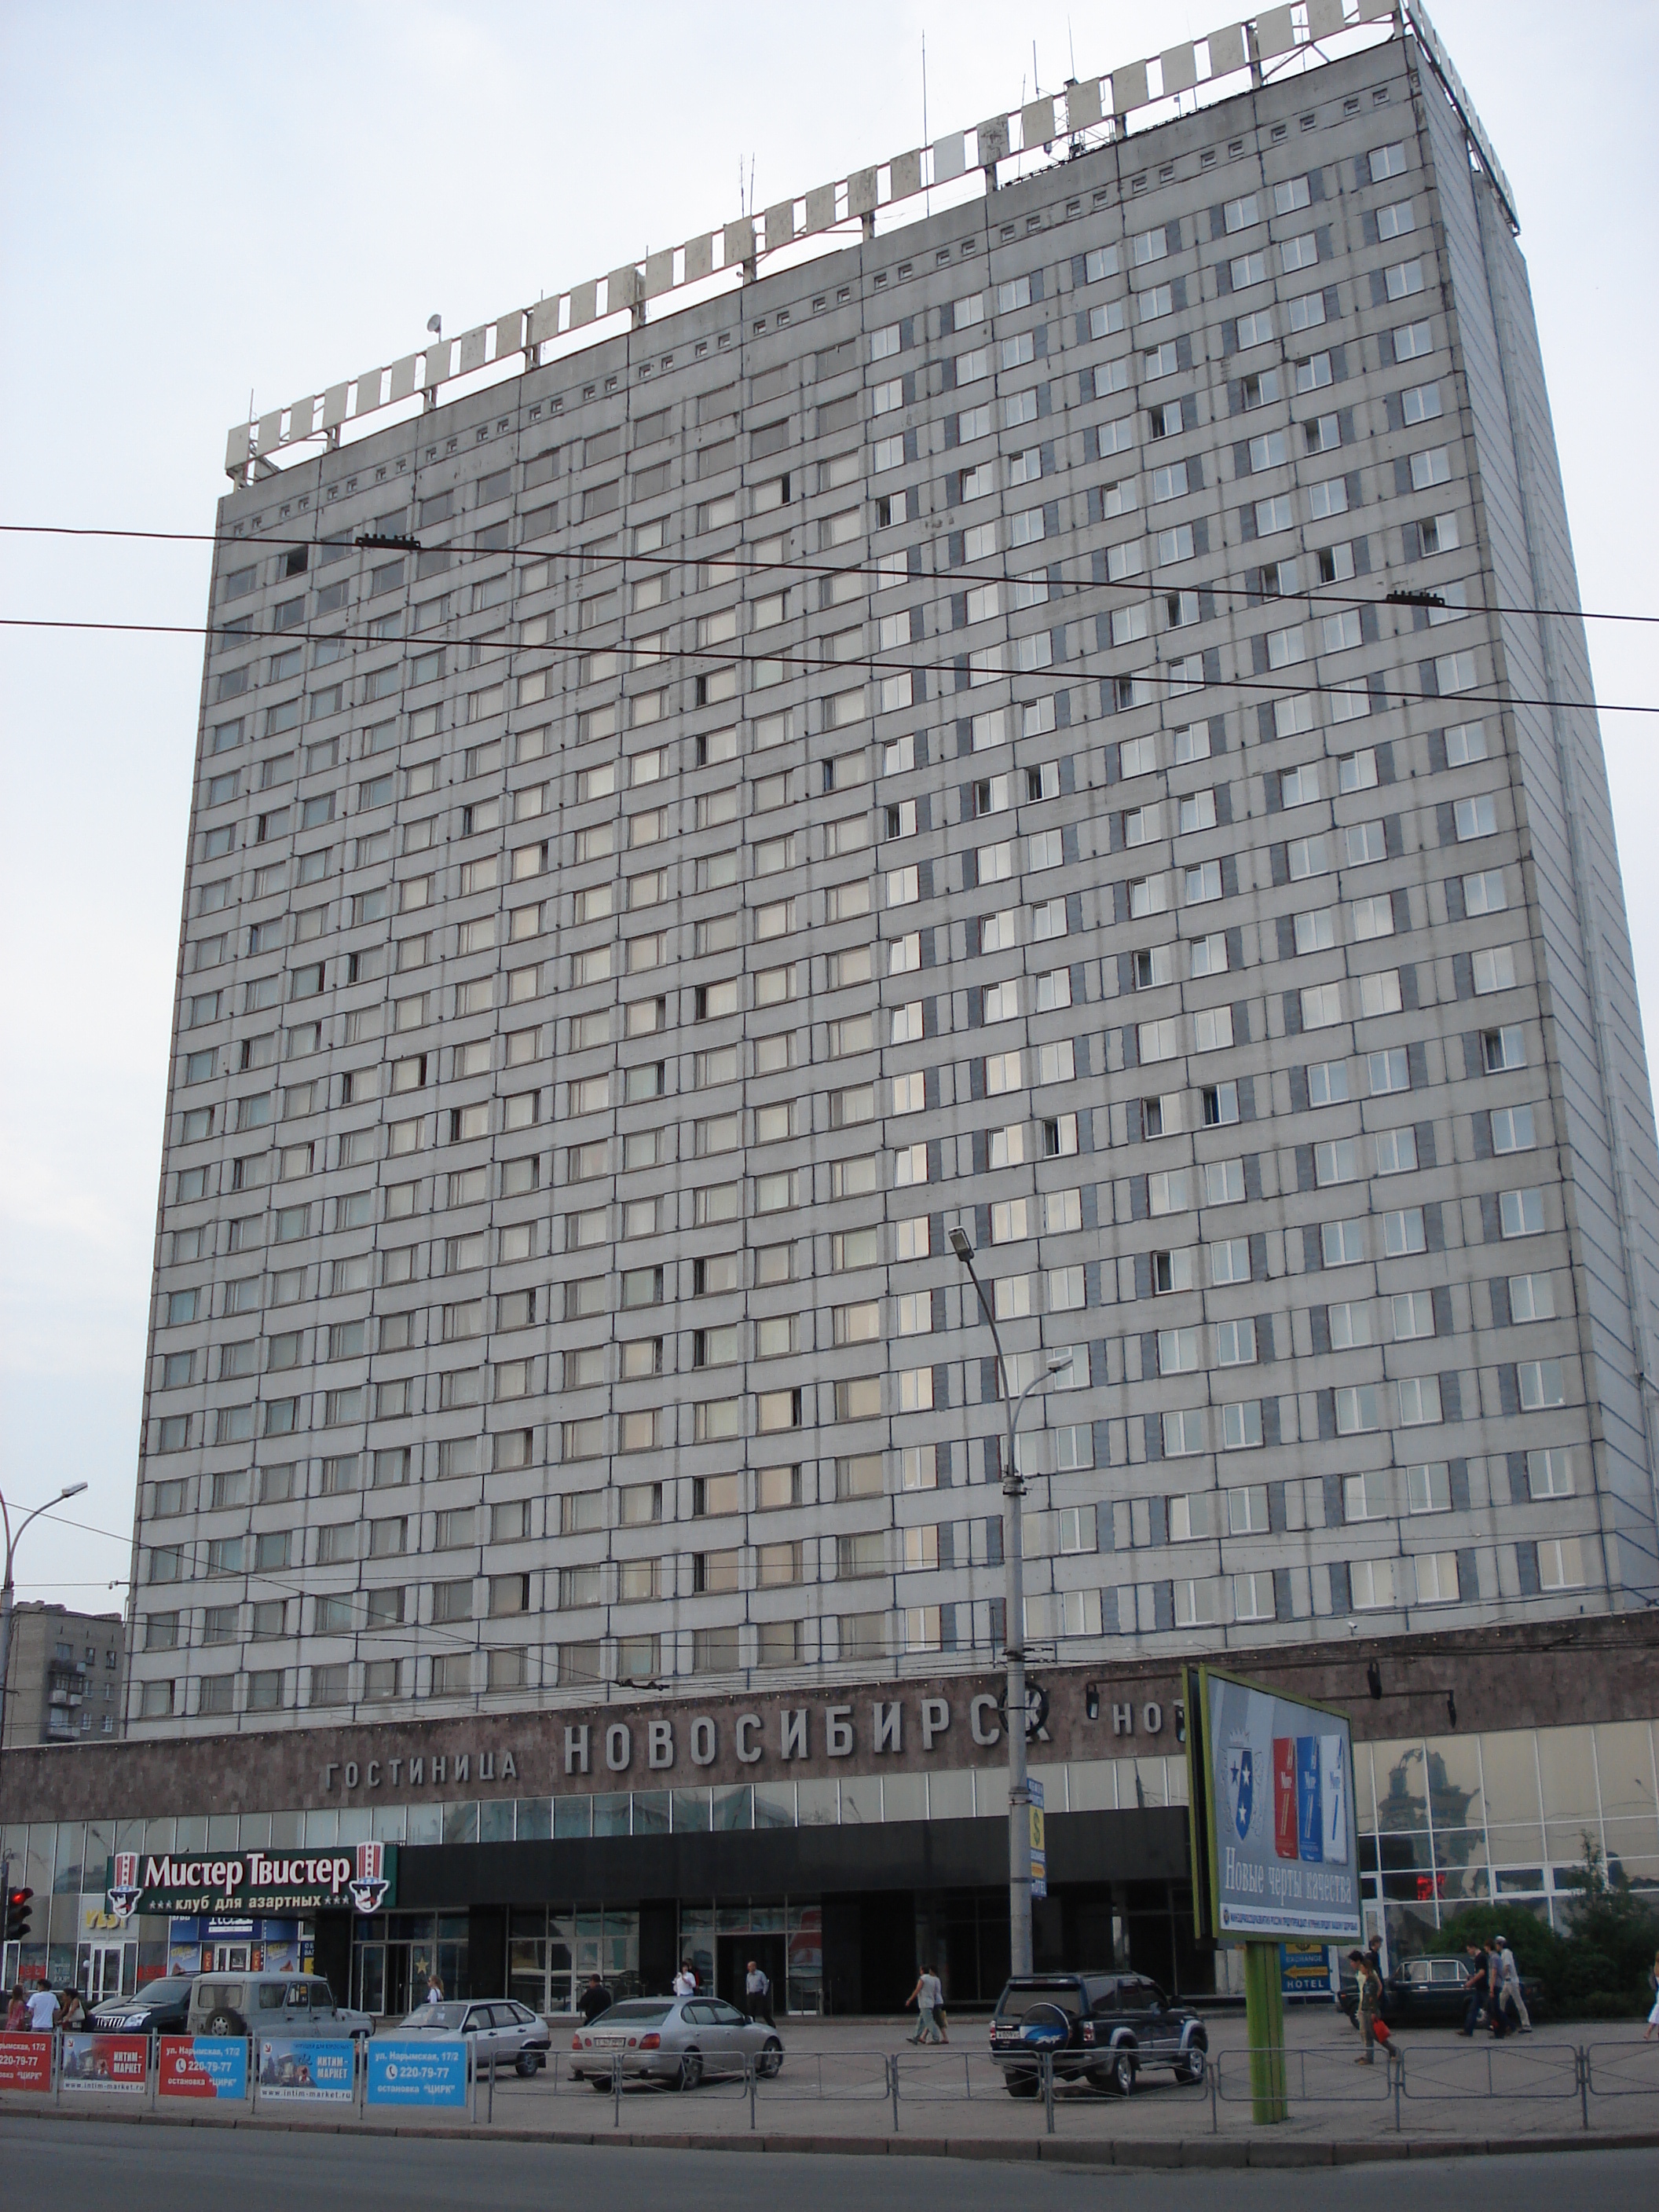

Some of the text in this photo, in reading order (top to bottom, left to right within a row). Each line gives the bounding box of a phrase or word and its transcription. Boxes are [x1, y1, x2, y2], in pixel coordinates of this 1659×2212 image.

[324, 1689, 1051, 1790] ГОСТИНИЦА НОВОСИБИРСК
[145, 1853, 351, 1895] Мистер Твистер
[1225, 1847, 1352, 1906] Новые черты качества
[175, 1895, 322, 1912] клуб для азартных
[1287, 1979, 1324, 1989] HOTEL
[32, 2042, 46, 2052] 17/2
[179, 2045, 224, 2056] Нарымская,
[225, 2047, 240, 2056] 17/2
[375, 2051, 459, 2063] ул. Нарымская, 17/2
[113, 2063, 142, 2074] МАРКЕТ
[189, 2060, 232, 2072] 220-79-77
[317, 2067, 347, 2079] МАРКЕТ
[400, 2067, 449, 2078] 220-79-77
[64, 2082, 145, 2091] www.intim-market.ru
[167, 2078, 206, 2086] остановка
[262, 2089, 351, 2099] www.intim-market.ru
[377, 2084, 419, 2093] остановка
